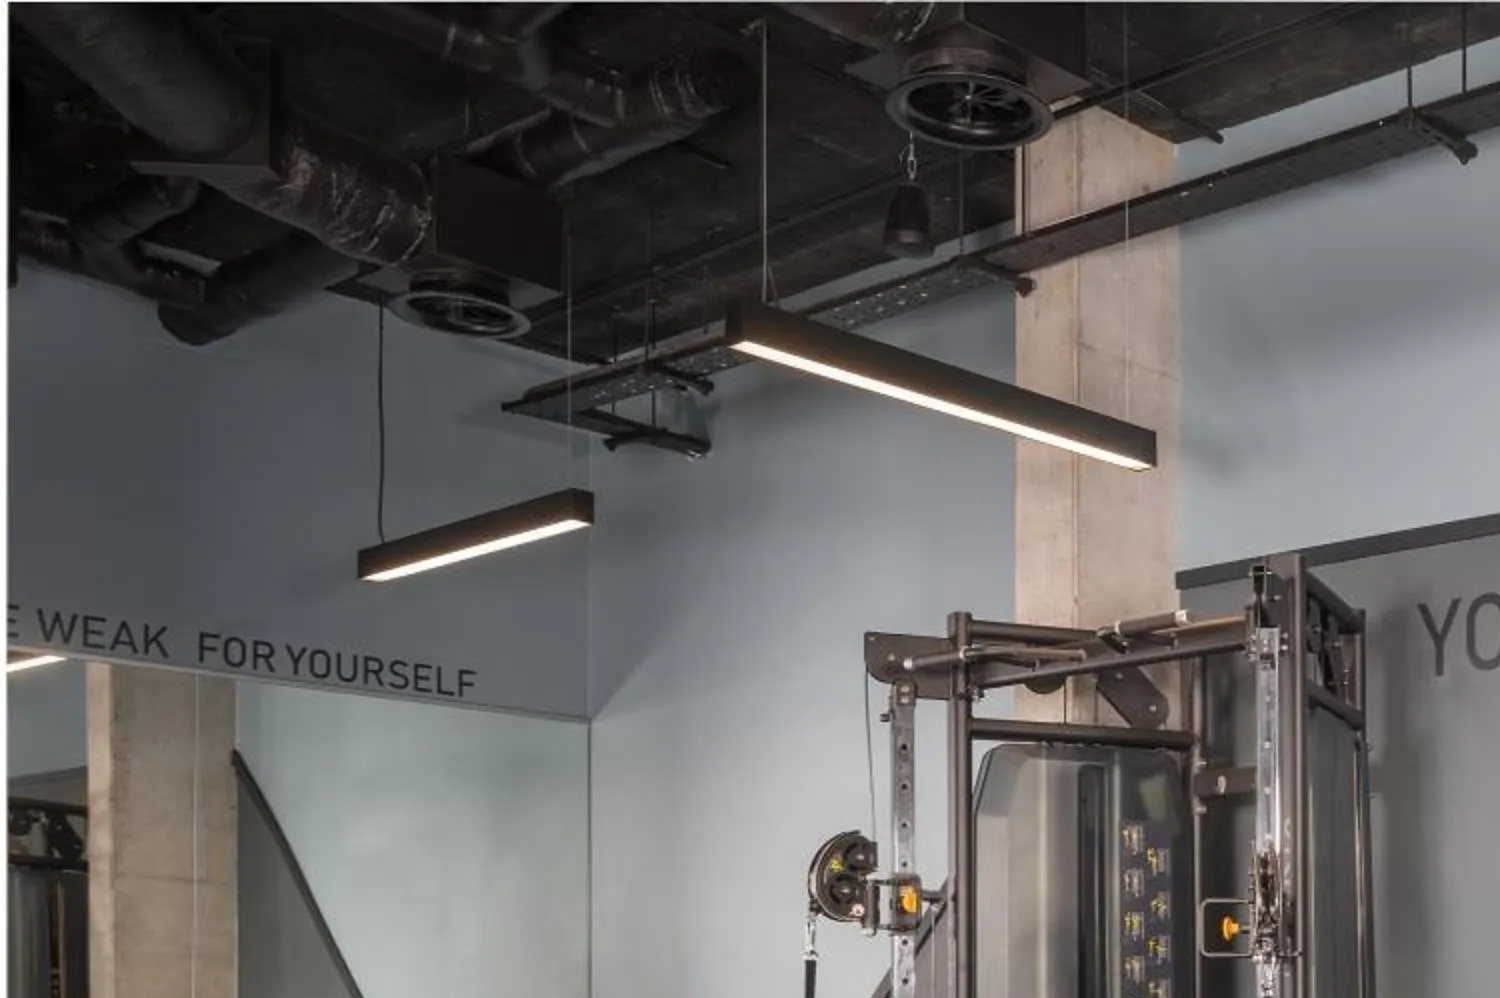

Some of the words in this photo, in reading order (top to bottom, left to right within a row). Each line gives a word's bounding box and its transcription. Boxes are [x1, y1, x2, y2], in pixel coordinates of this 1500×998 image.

[37, 608, 169, 658] WEAK
[198, 632, 276, 673] FOR
[285, 643, 477, 697] YOURSELF
